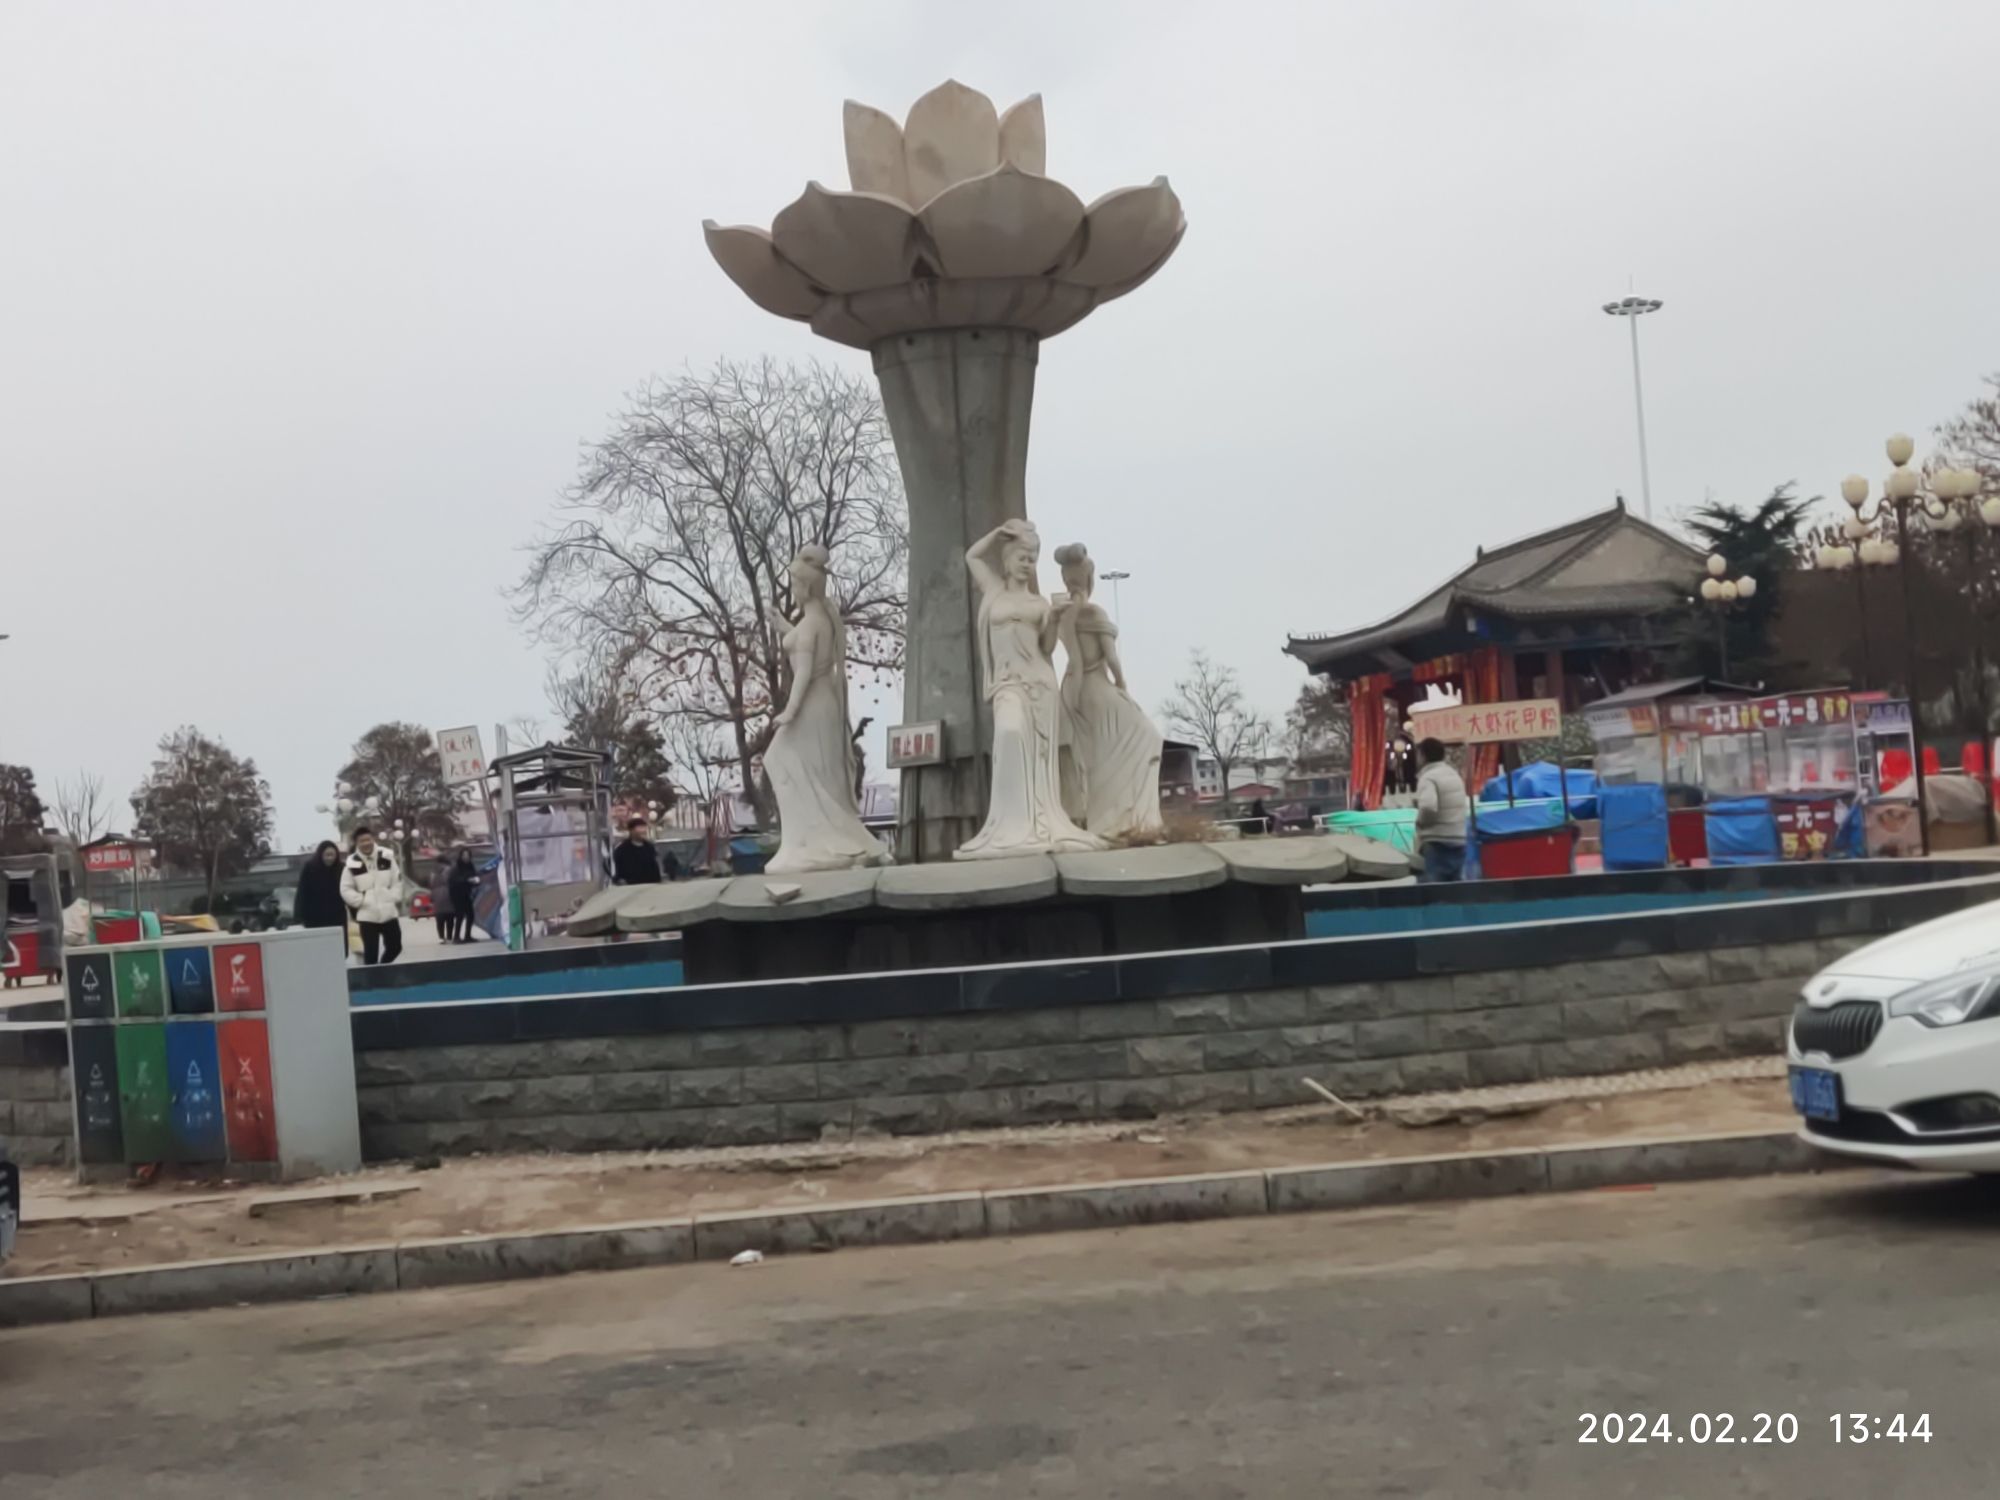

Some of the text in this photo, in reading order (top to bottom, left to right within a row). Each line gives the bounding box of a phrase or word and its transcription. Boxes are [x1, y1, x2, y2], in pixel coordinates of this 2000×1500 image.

[1467, 706, 1558, 736] 大虾花甲粉
